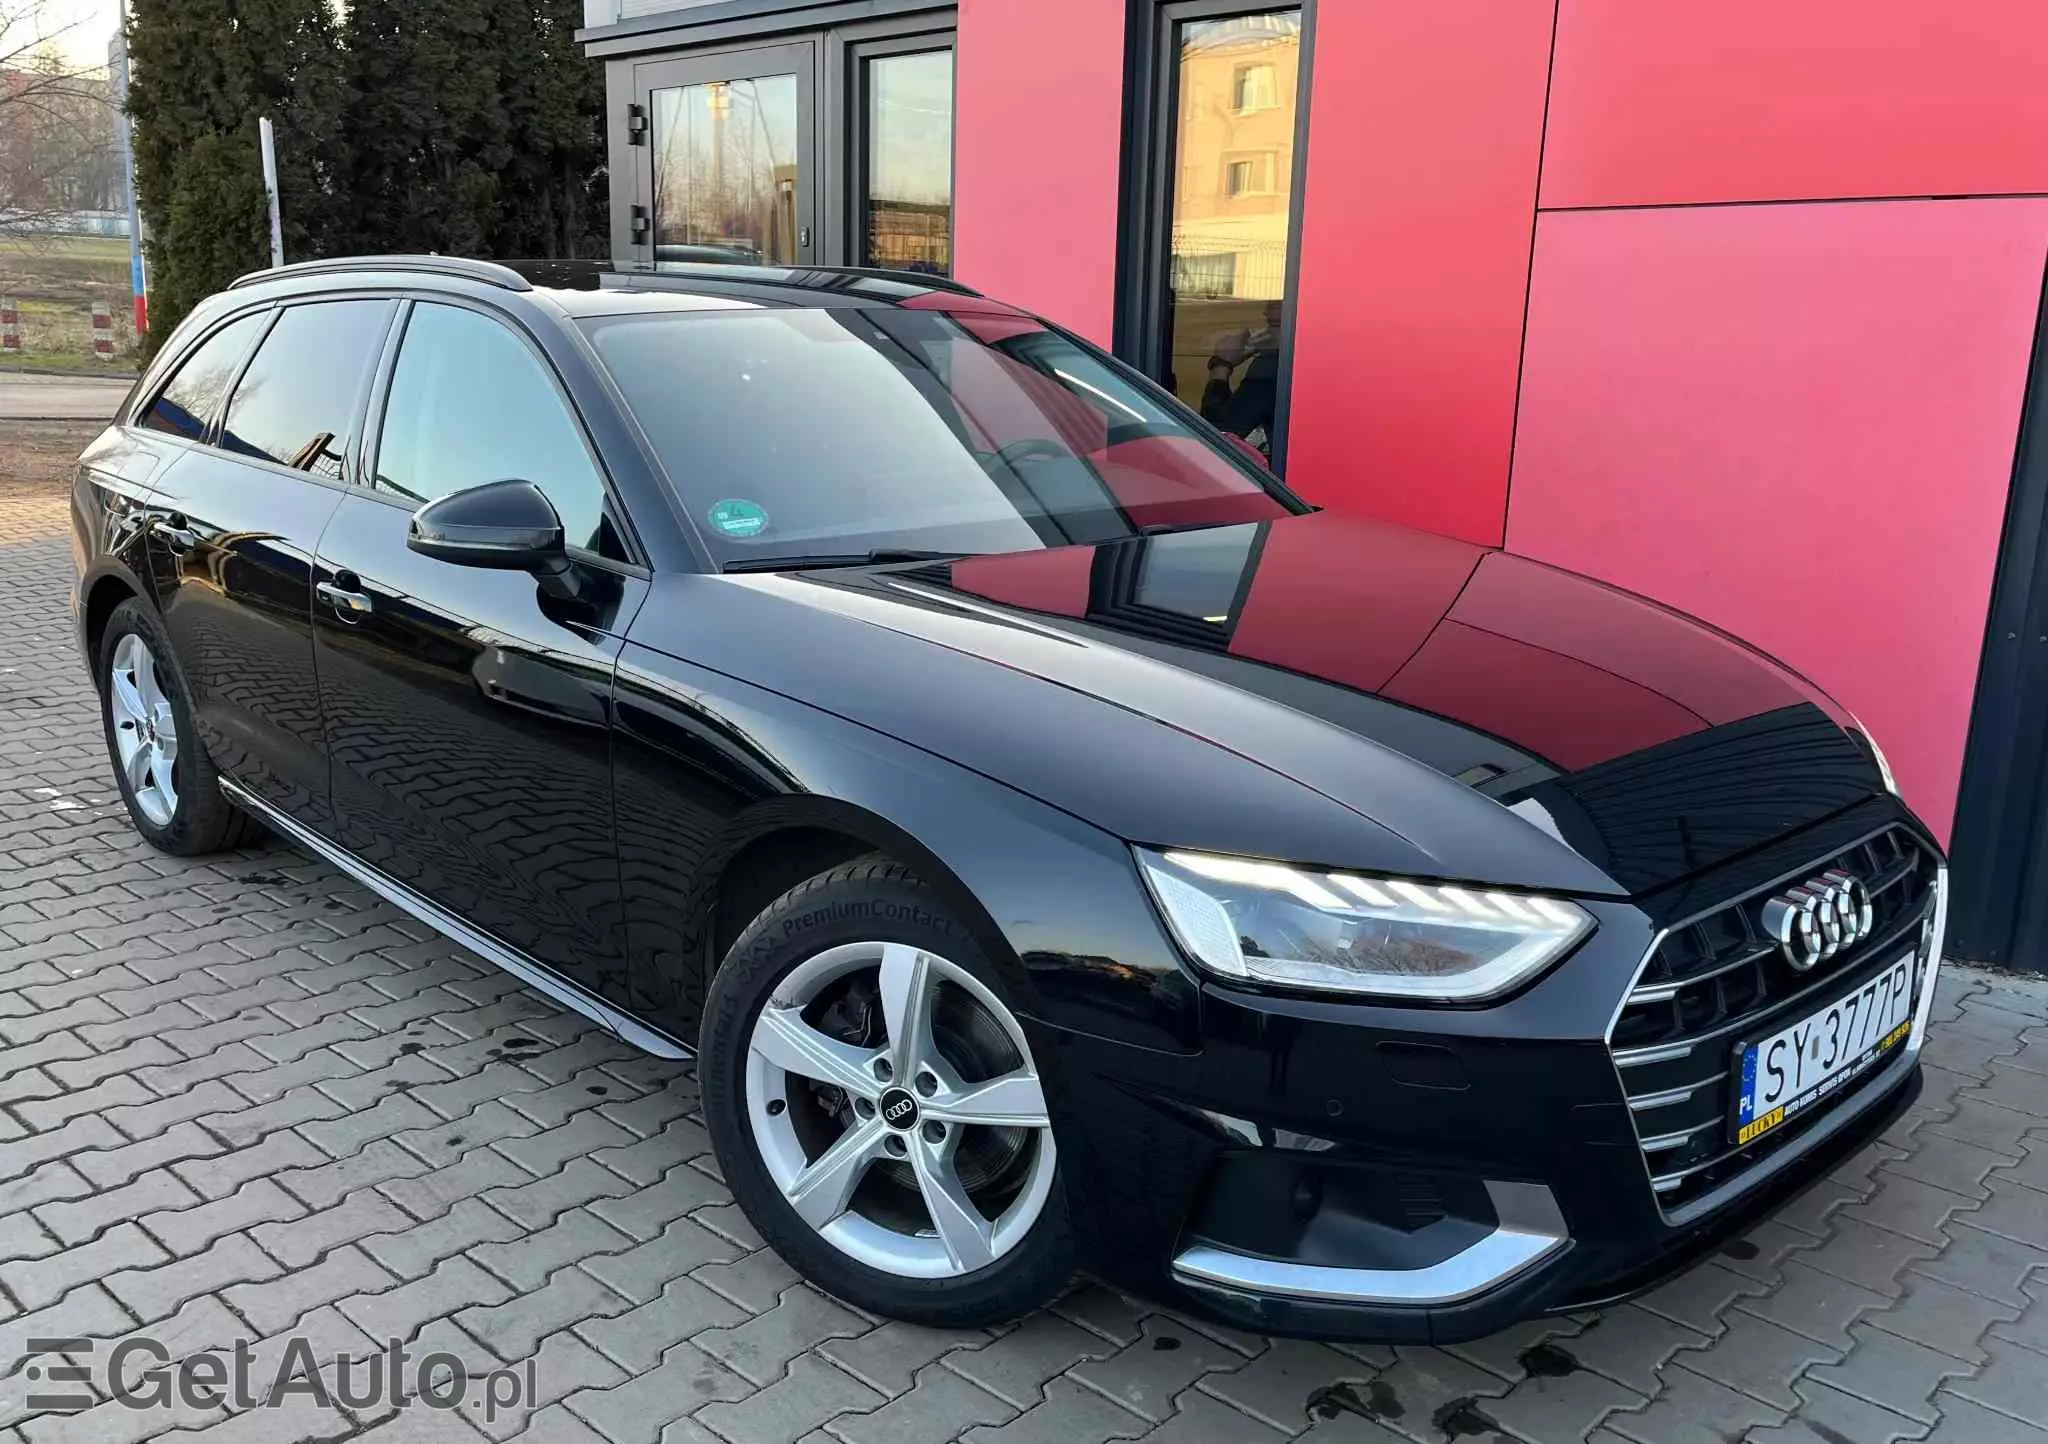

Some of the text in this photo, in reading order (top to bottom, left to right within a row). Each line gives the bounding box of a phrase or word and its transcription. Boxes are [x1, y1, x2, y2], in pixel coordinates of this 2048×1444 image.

[782, 900, 951, 938] PremiumContact
[1765, 963, 1907, 1103] SY 3777P
[1739, 1094, 1753, 1115] PL
